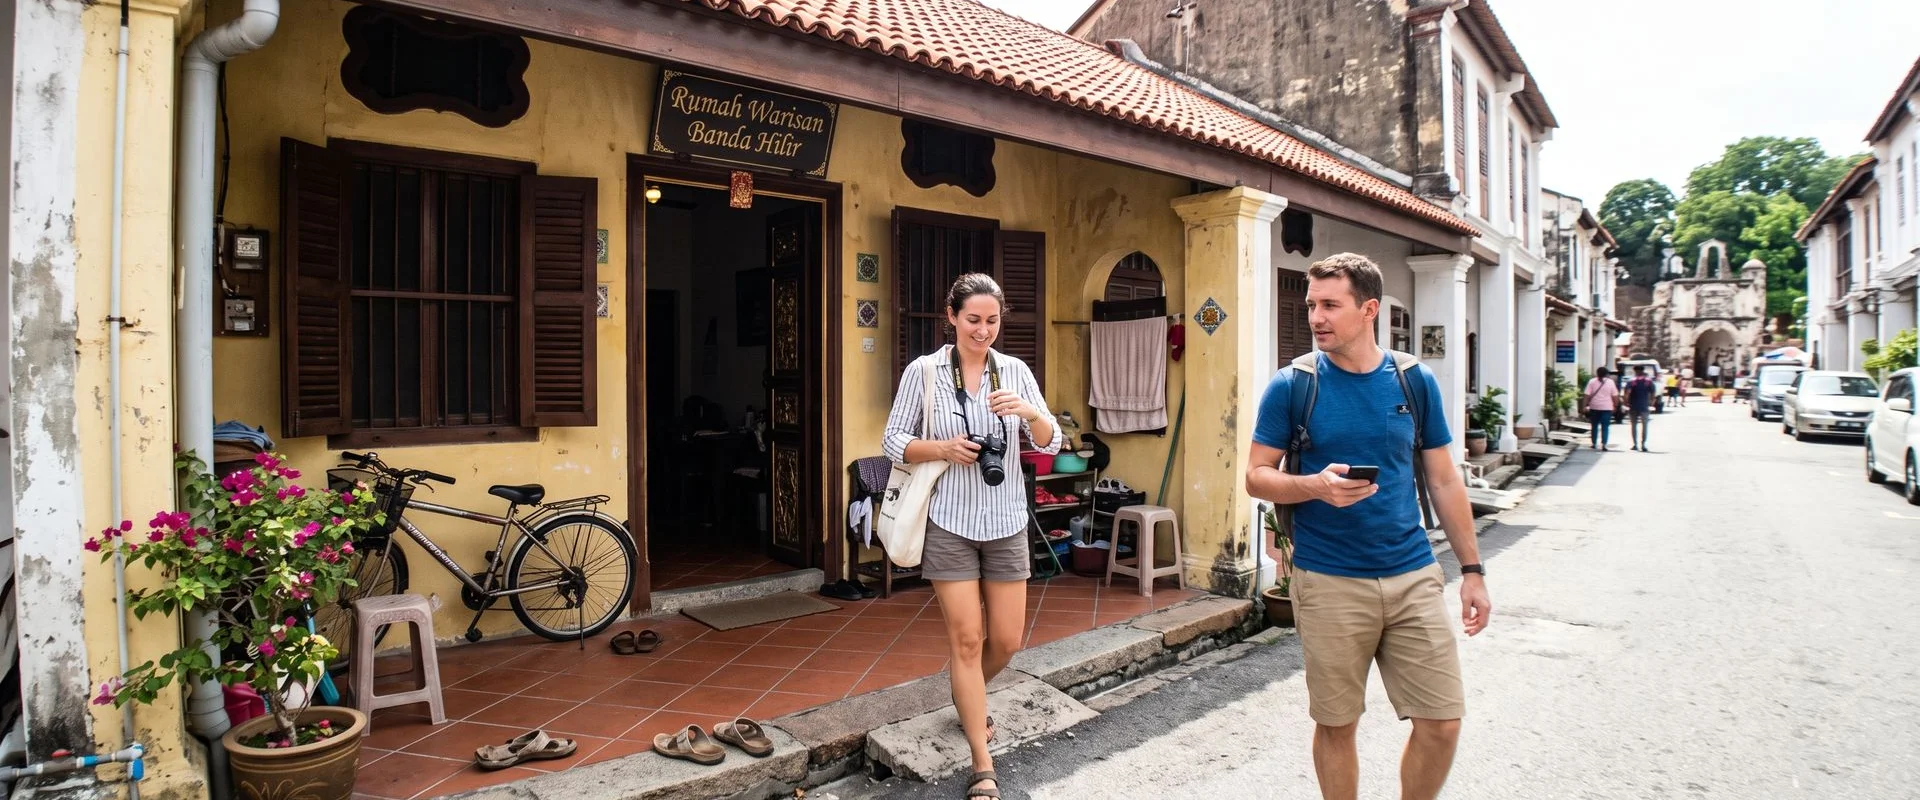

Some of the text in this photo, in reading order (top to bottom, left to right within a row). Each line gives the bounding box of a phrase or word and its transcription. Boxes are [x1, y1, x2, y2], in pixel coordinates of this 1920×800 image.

[671, 86, 824, 133] Rumah Warisan
[687, 120, 803, 157] Banda Hilir
